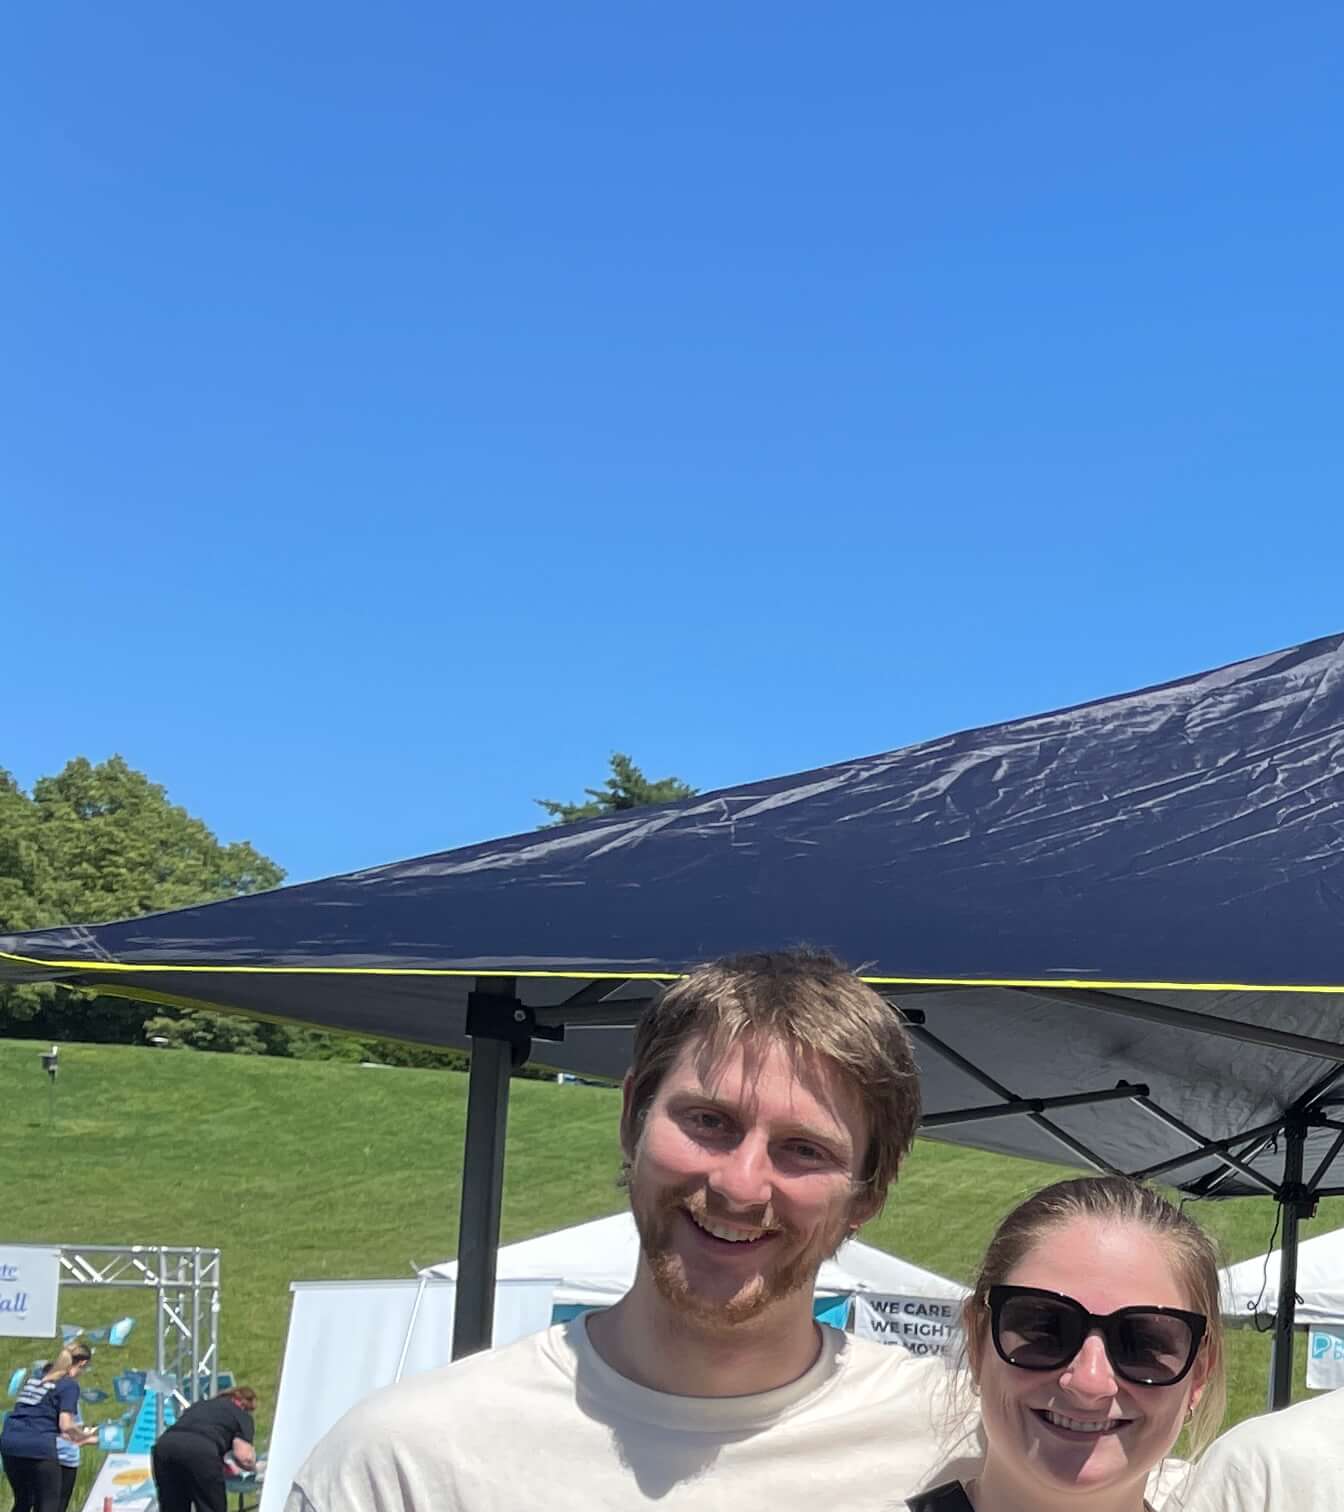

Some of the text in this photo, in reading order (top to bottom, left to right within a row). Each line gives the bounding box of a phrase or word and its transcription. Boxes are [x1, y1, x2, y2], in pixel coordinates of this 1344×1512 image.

[871, 1301, 952, 1318] WE CARE
[871, 1320, 900, 1334] WE
